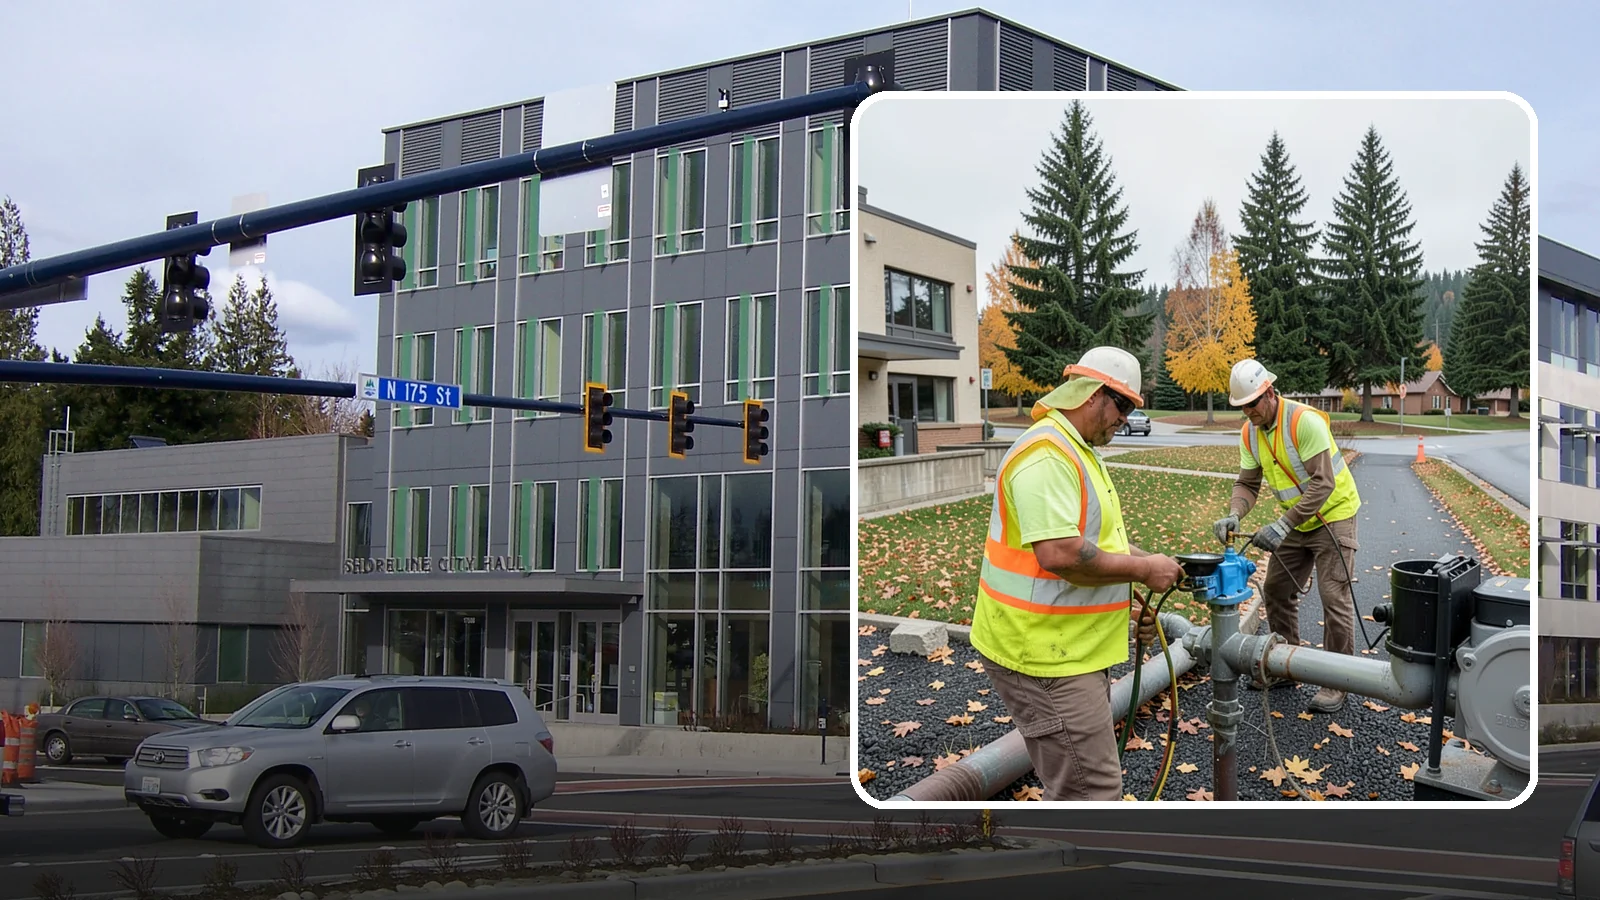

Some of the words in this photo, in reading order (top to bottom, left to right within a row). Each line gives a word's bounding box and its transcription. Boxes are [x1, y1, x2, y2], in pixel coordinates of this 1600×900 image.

[387, 381, 396, 400] N
[405, 382, 427, 403] 175
[436, 386, 451, 406] St
[344, 556, 432, 574] SHORELINE
[438, 556, 475, 572] CITY
[484, 555, 525, 571] HALL
